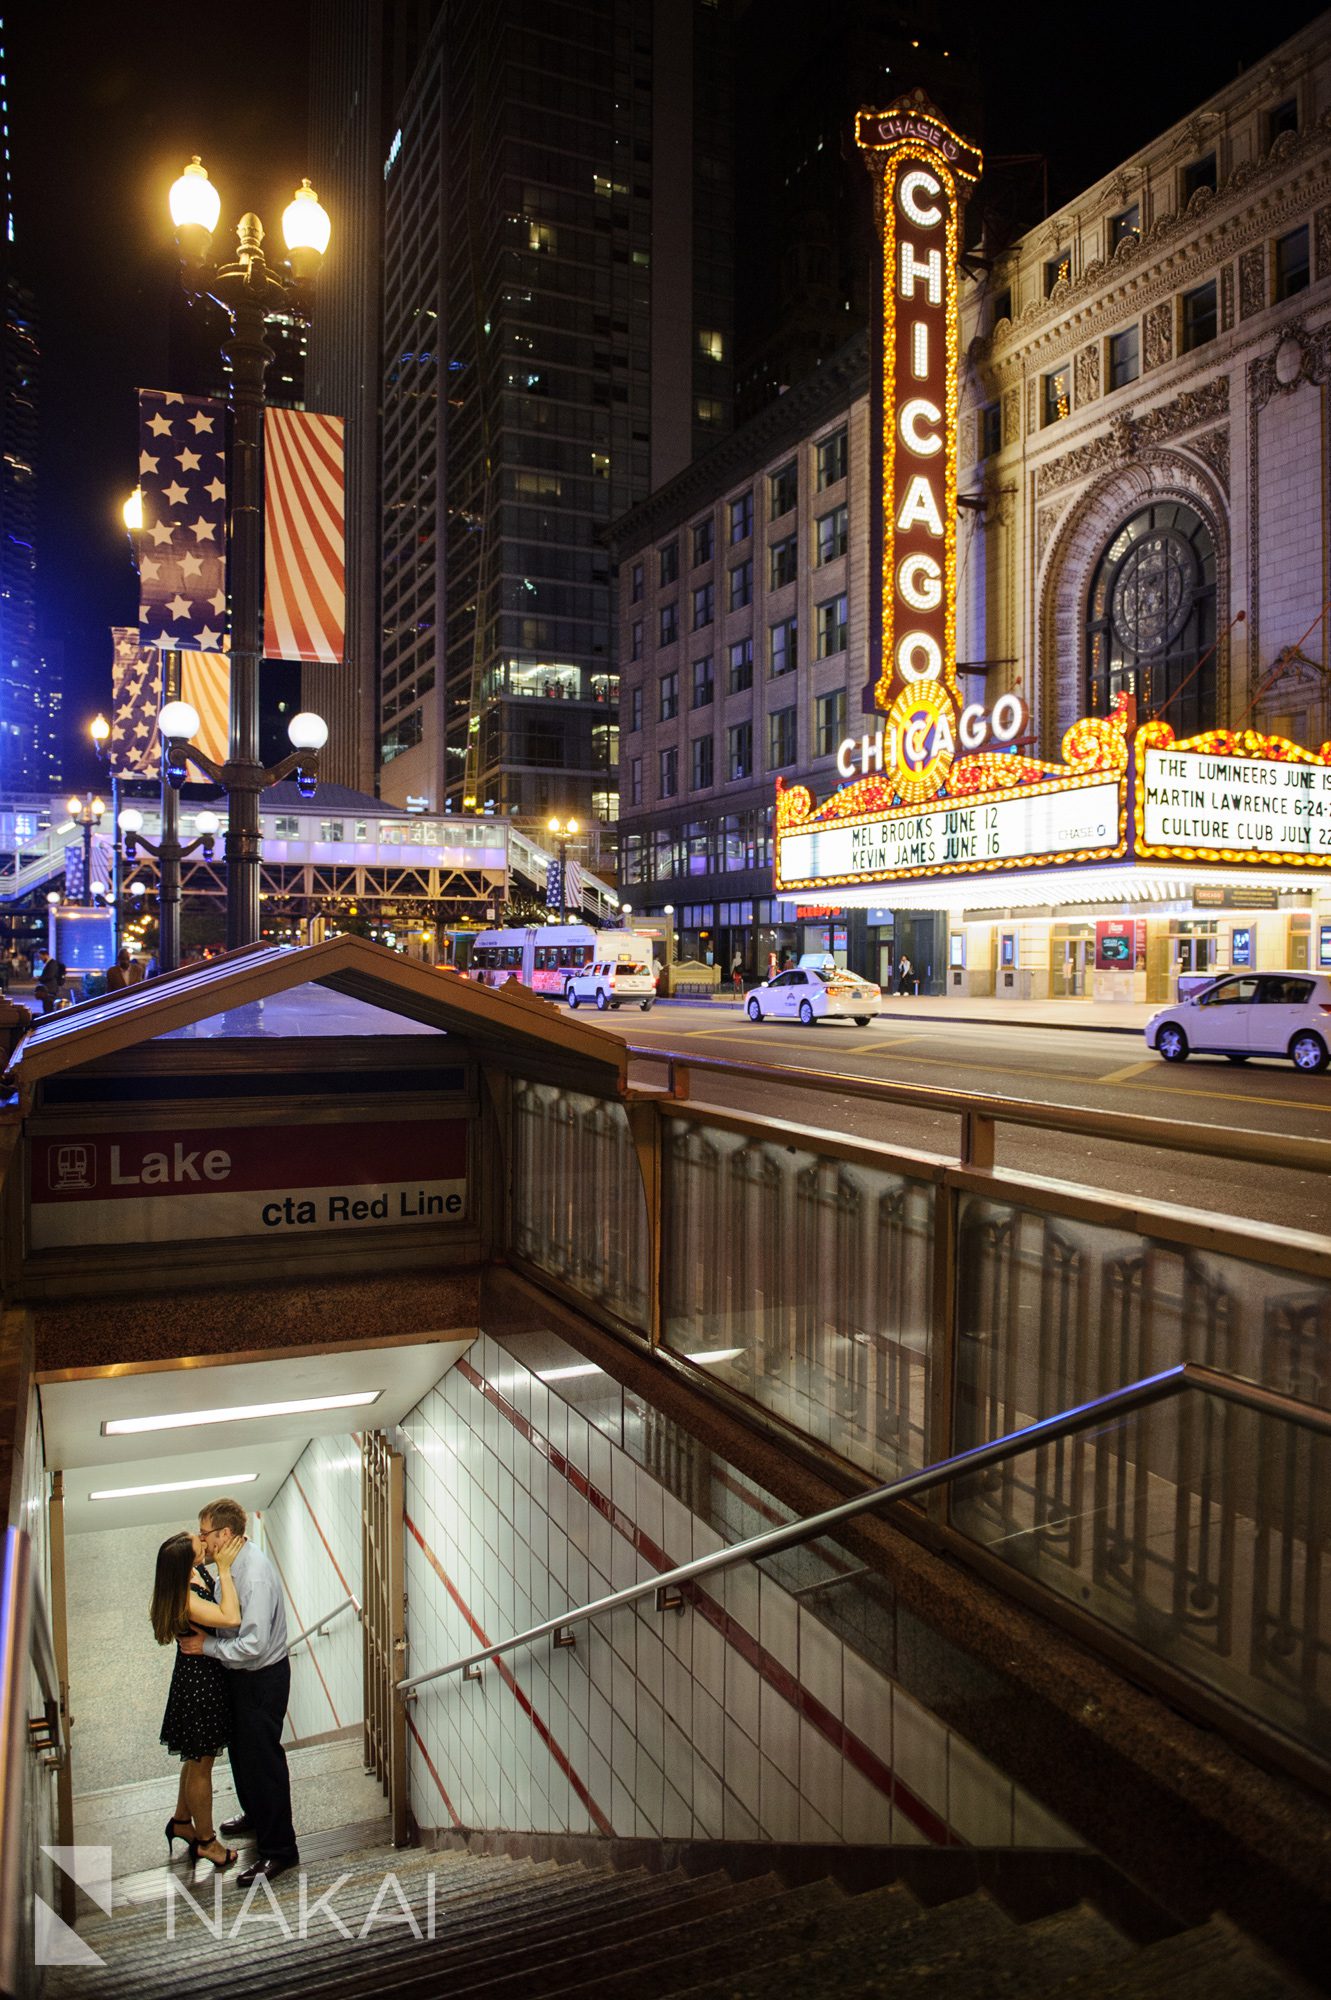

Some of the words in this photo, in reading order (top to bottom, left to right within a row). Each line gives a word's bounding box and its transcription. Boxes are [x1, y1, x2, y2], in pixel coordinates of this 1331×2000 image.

[878, 120, 941, 146] CHASE
[896, 171, 945, 682] CHICAGO
[837, 694, 1023, 778] CHICAGO
[1159, 758, 1187, 778] THE
[1198, 762, 1277, 785] LUMINEERS
[1284, 770, 1316, 789] JUNE
[1146, 787, 1205, 809] MARTIN
[1211, 792, 1288, 815] LAWRENCE
[1294, 799, 1331, 817] 6-24-
[852, 827, 874, 847] MEL
[881, 818, 933, 844] BROOKS
[942, 810, 976, 835] JUNE
[985, 807, 998, 829] 12
[1162, 818, 1229, 839] CULTURE
[1237, 823, 1274, 842] CLUB
[1280, 826, 1312, 844] JULY
[852, 848, 886, 870] KEVIN
[894, 842, 936, 865] JAMES
[943, 835, 977, 860] JUNE
[987, 832, 1000, 855] 16
[110, 1142, 232, 1185] Lake
[261, 1198, 317, 1226] cta
[329, 1194, 388, 1221] Red
[400, 1191, 462, 1217] Line
